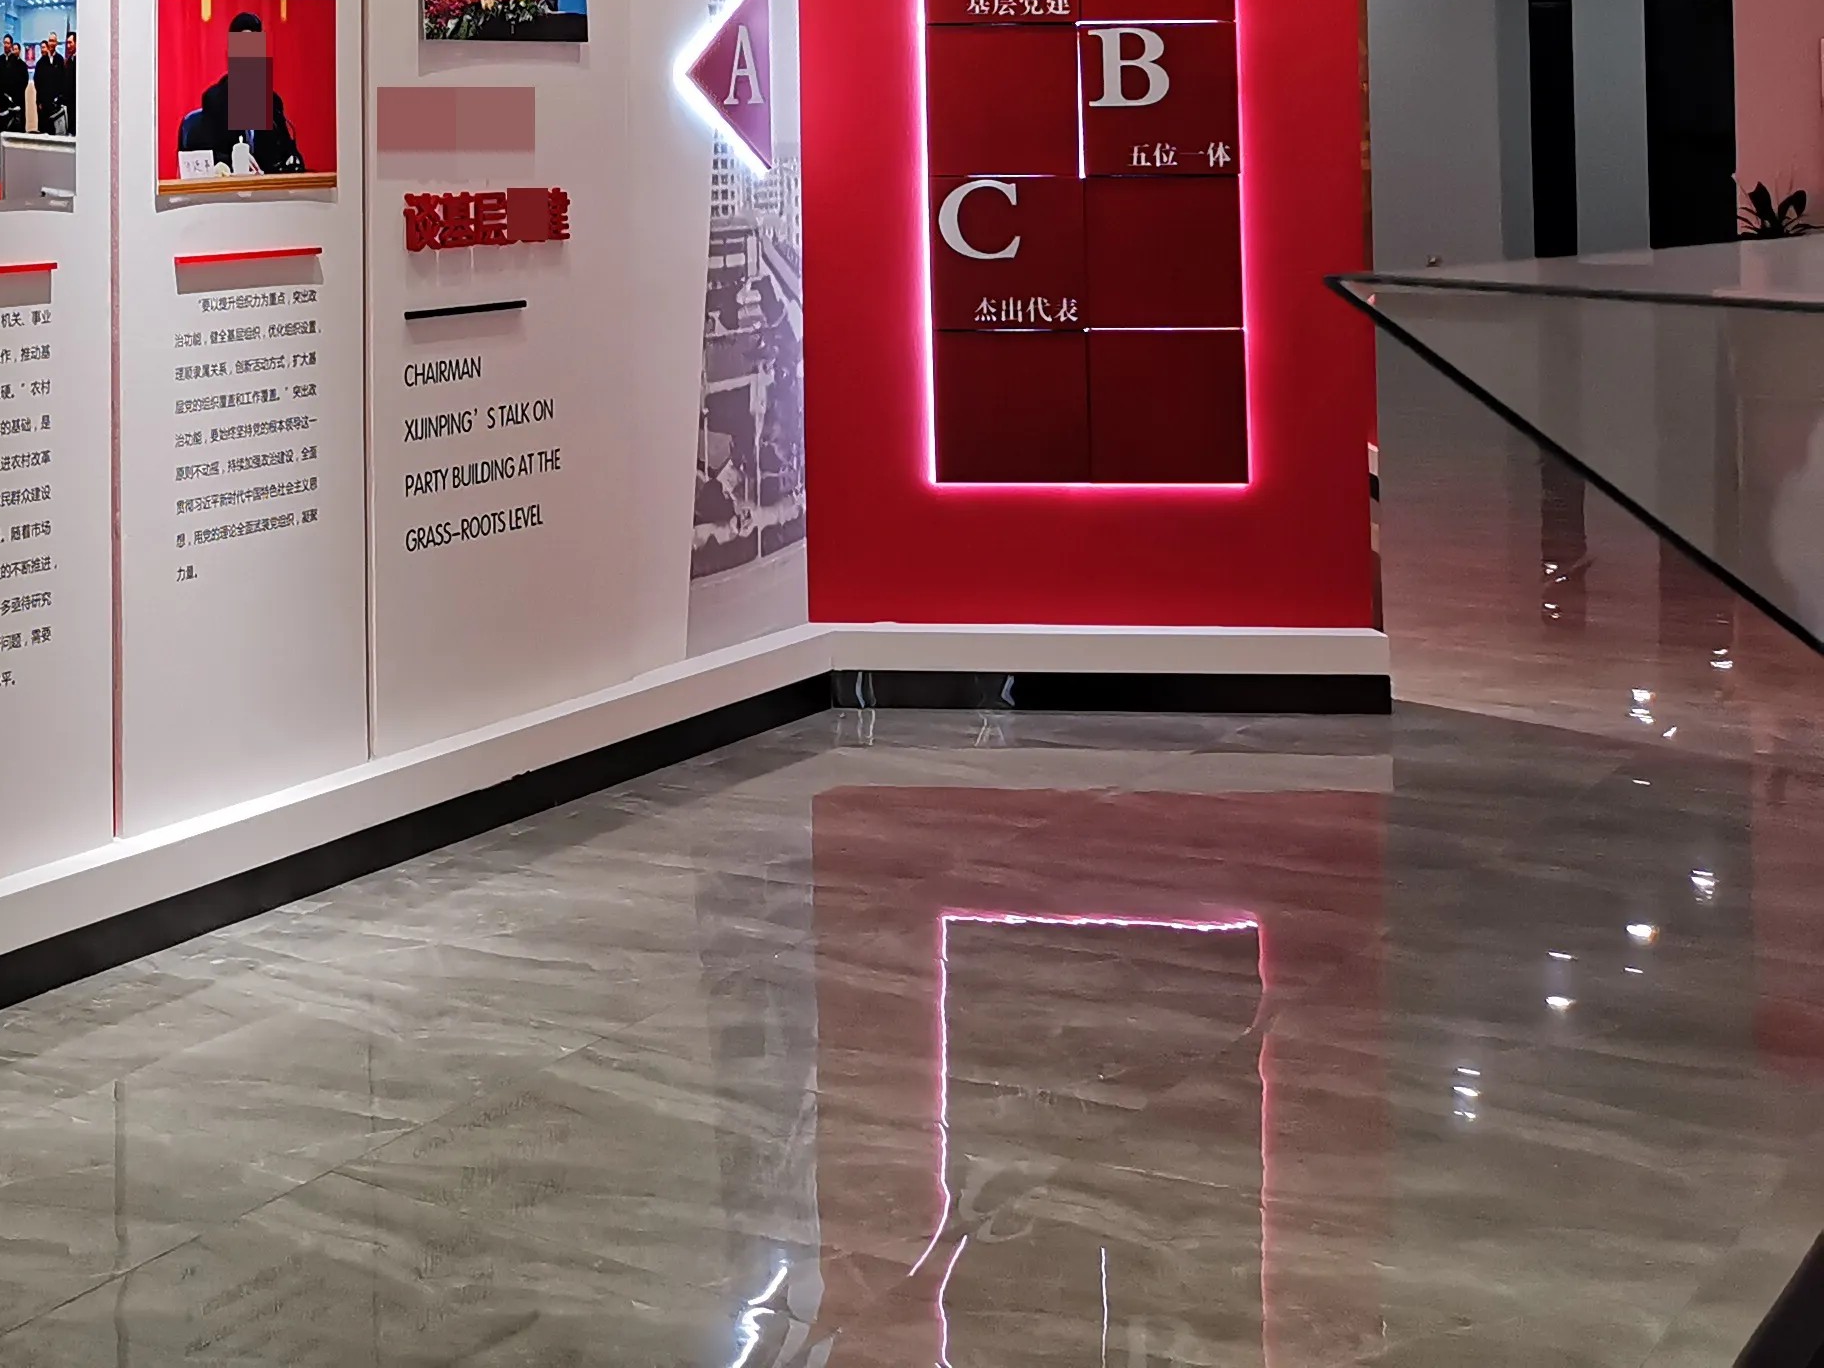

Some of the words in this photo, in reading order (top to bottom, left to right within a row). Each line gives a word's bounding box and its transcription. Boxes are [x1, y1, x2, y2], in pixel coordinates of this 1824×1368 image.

[724, 24, 765, 105] A
[1088, 28, 1170, 107] B
[1128, 142, 1232, 168] 五位一体
[938, 180, 1021, 260] C
[973, 297, 1079, 323] 杰出代表
[405, 356, 481, 387] CHAIRMAN
[499, 401, 531, 426] TALK
[533, 398, 554, 420] ON
[405, 468, 448, 497] PARTY
[453, 457, 514, 488] BUILDING
[518, 453, 533, 477] AT
[536, 448, 561, 473] THE
[509, 504, 543, 531] LEVEL
